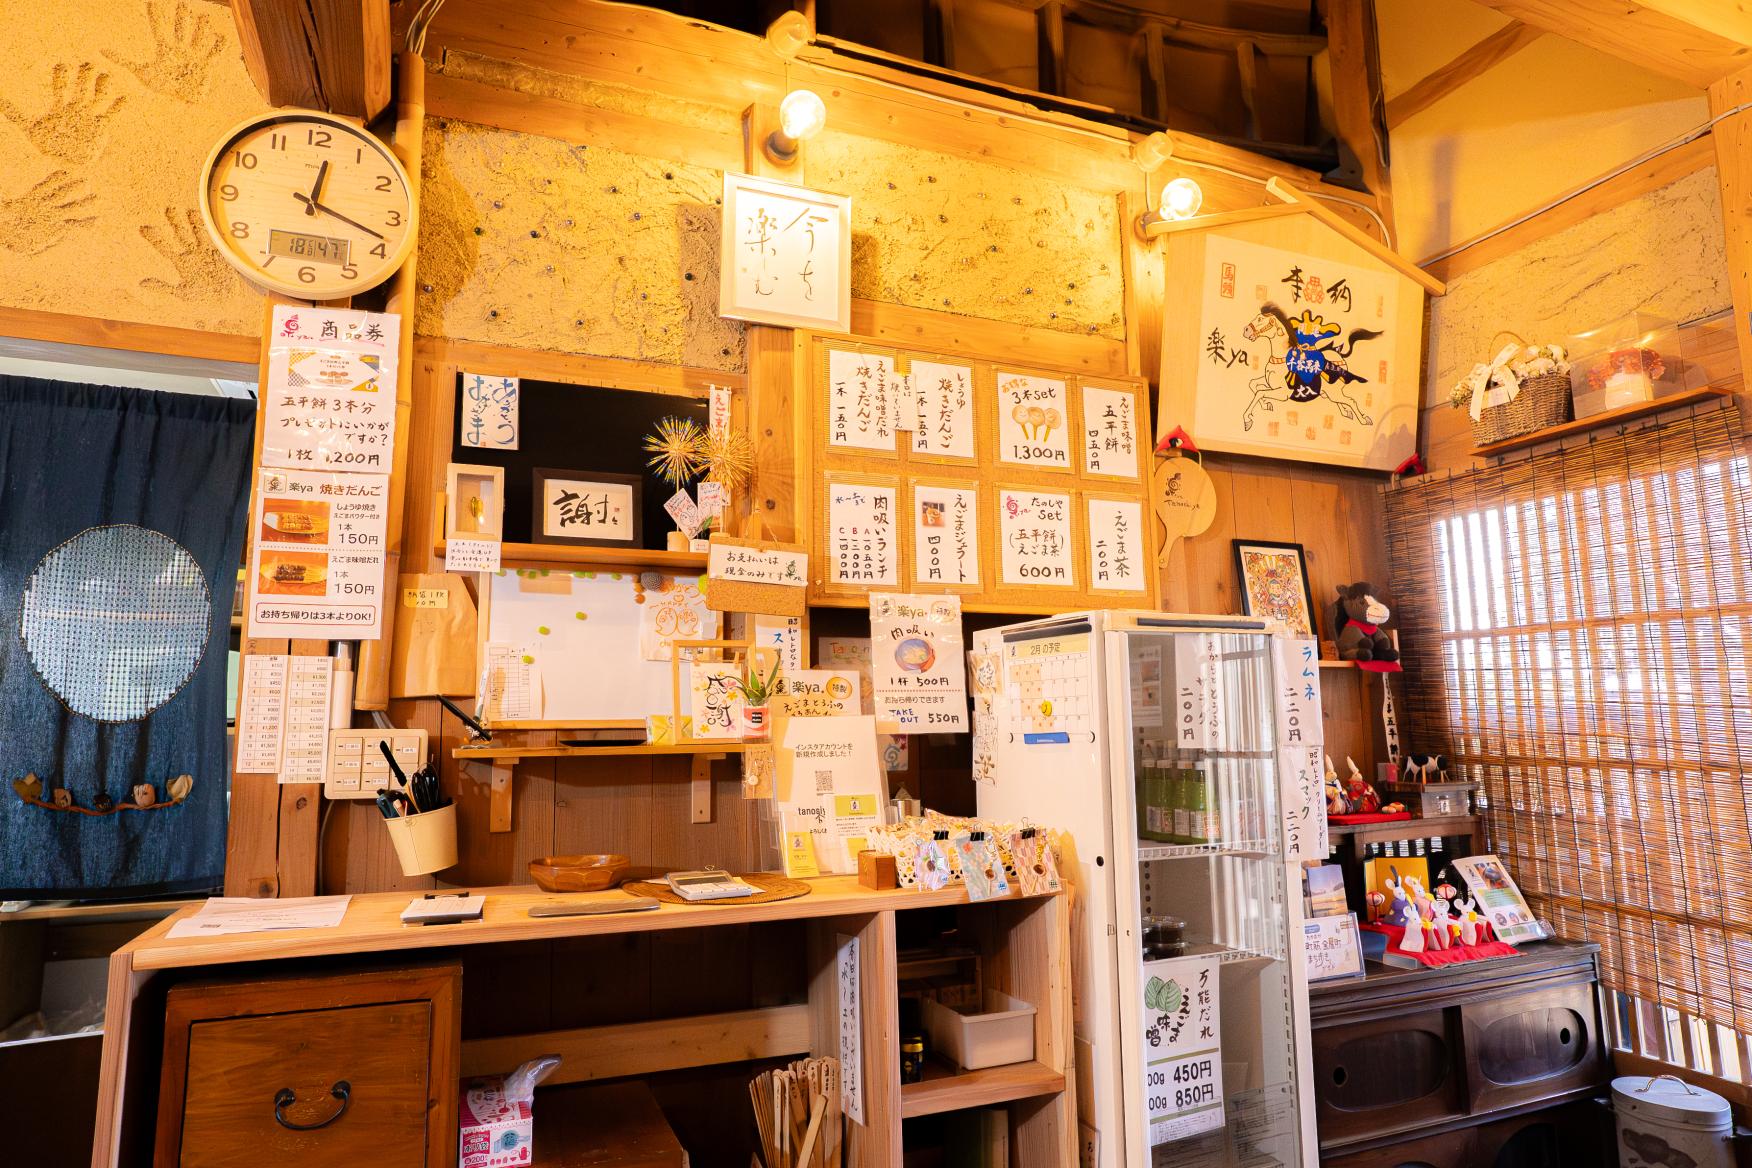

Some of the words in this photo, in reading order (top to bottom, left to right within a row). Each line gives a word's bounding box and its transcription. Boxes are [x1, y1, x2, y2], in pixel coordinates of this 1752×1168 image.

[271, 133, 287, 151] 11
[308, 129, 332, 148] 12
[235, 151, 258, 169] 10
[375, 175, 392, 192] 2
[219, 184, 239, 201] 9
[385, 210, 401, 227] 3
[230, 221, 249, 239] 8
[369, 243, 387, 259] 4
[297, 266, 316, 283] 6
[340, 263, 358, 280] 5
[321, 319, 384, 343] 商品券
[1206, 327, 1249, 369] 楽ya
[856, 366, 873, 433] 焼きだんご
[875, 360, 889, 438] えごま味噌だれ
[938, 377, 954, 449] 焼きだんご
[1102, 405, 1119, 453] 五平餅
[289, 482, 314, 493] 楽ya
[319, 483, 383, 497] 焼きだんご
[336, 502, 376, 512] しょうゆ焼き
[338, 523, 353, 531] 1本
[339, 533, 379, 545] 150円
[873, 494, 890, 579] 肉吸いランチ
[1113, 510, 1131, 578] えごま茶
[331, 555, 380, 564] えごま味噌だれ
[726, 551, 779, 565] お支払いは
[335, 570, 350, 579] 1本
[1019, 563, 1065, 579] 600円
[334, 583, 375, 595] 150円
[890, 624, 935, 640] 肉吸い
[1302, 646, 1315, 701] ラムネ
[889, 708, 914, 717] TAKE
[900, 716, 919, 724] OUT
[928, 713, 960, 724] 550円
[795, 743, 853, 751] インスタアカウントを
[1197, 968, 1214, 1040] 万能だれ
[1173, 1059, 1212, 1084] 450円
[1175, 1083, 1214, 1108] 850円
